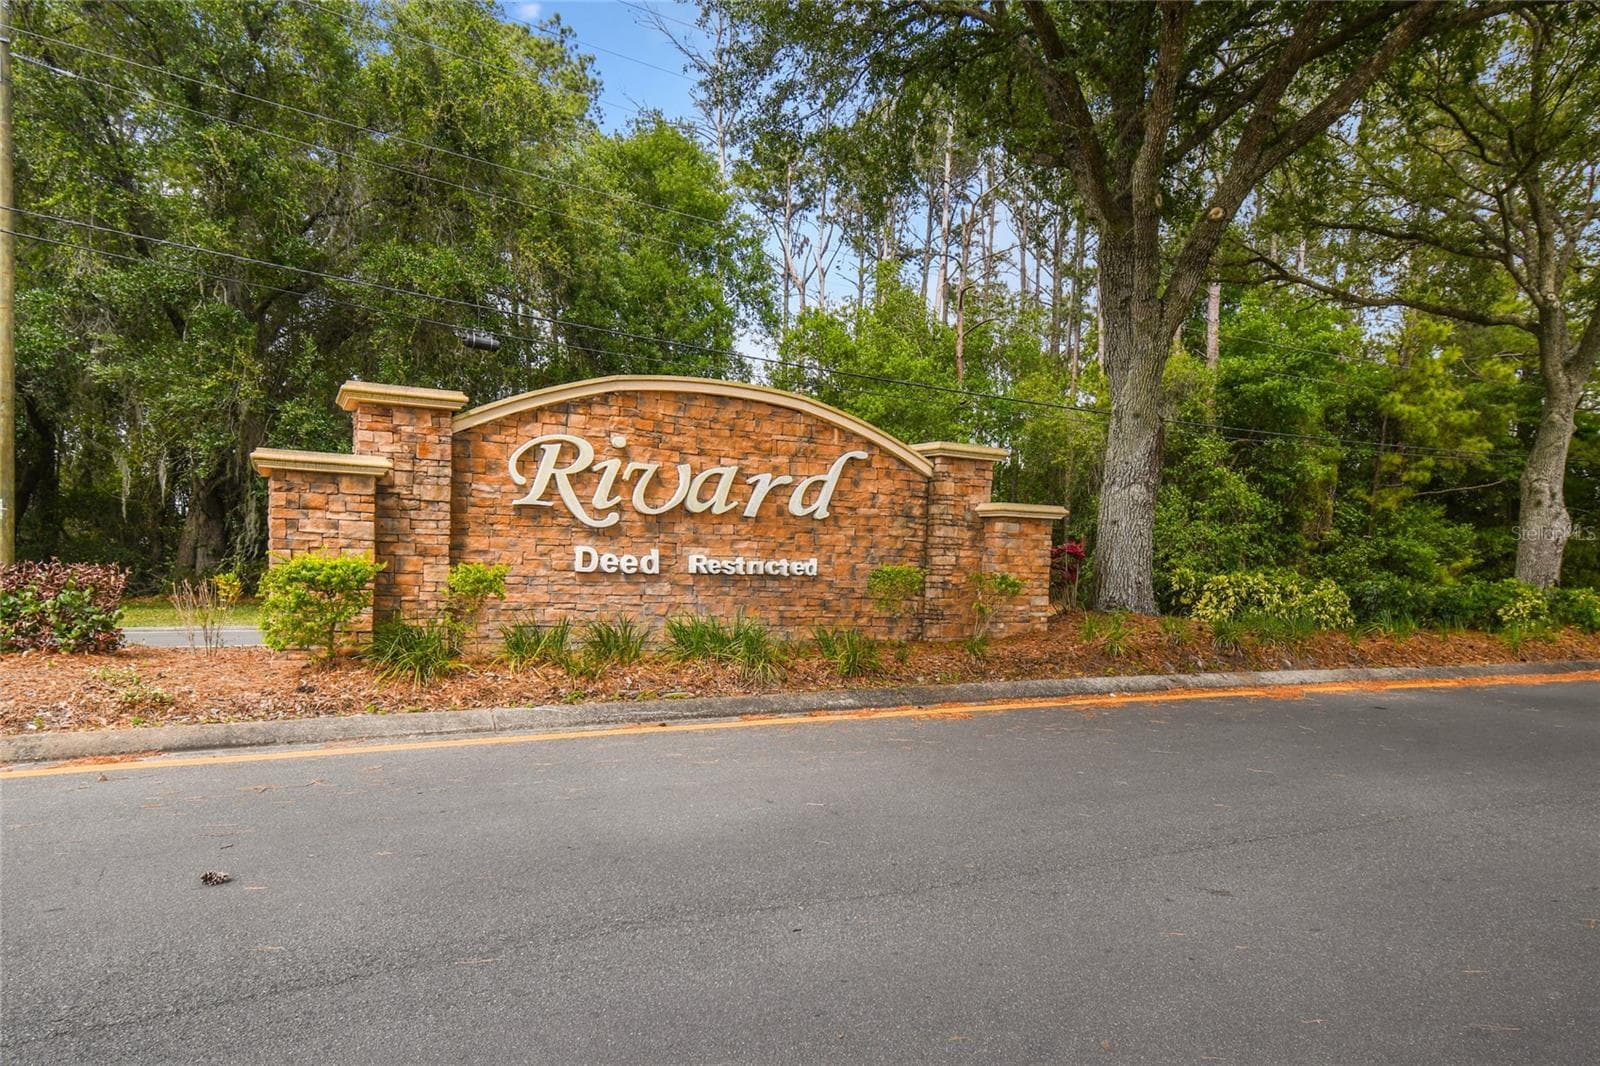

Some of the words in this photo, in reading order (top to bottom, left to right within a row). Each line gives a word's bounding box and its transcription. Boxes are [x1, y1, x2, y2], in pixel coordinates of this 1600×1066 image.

[508, 434, 869, 528] Rivard
[574, 546, 660, 575] Deed
[688, 554, 819, 577] Restricted
